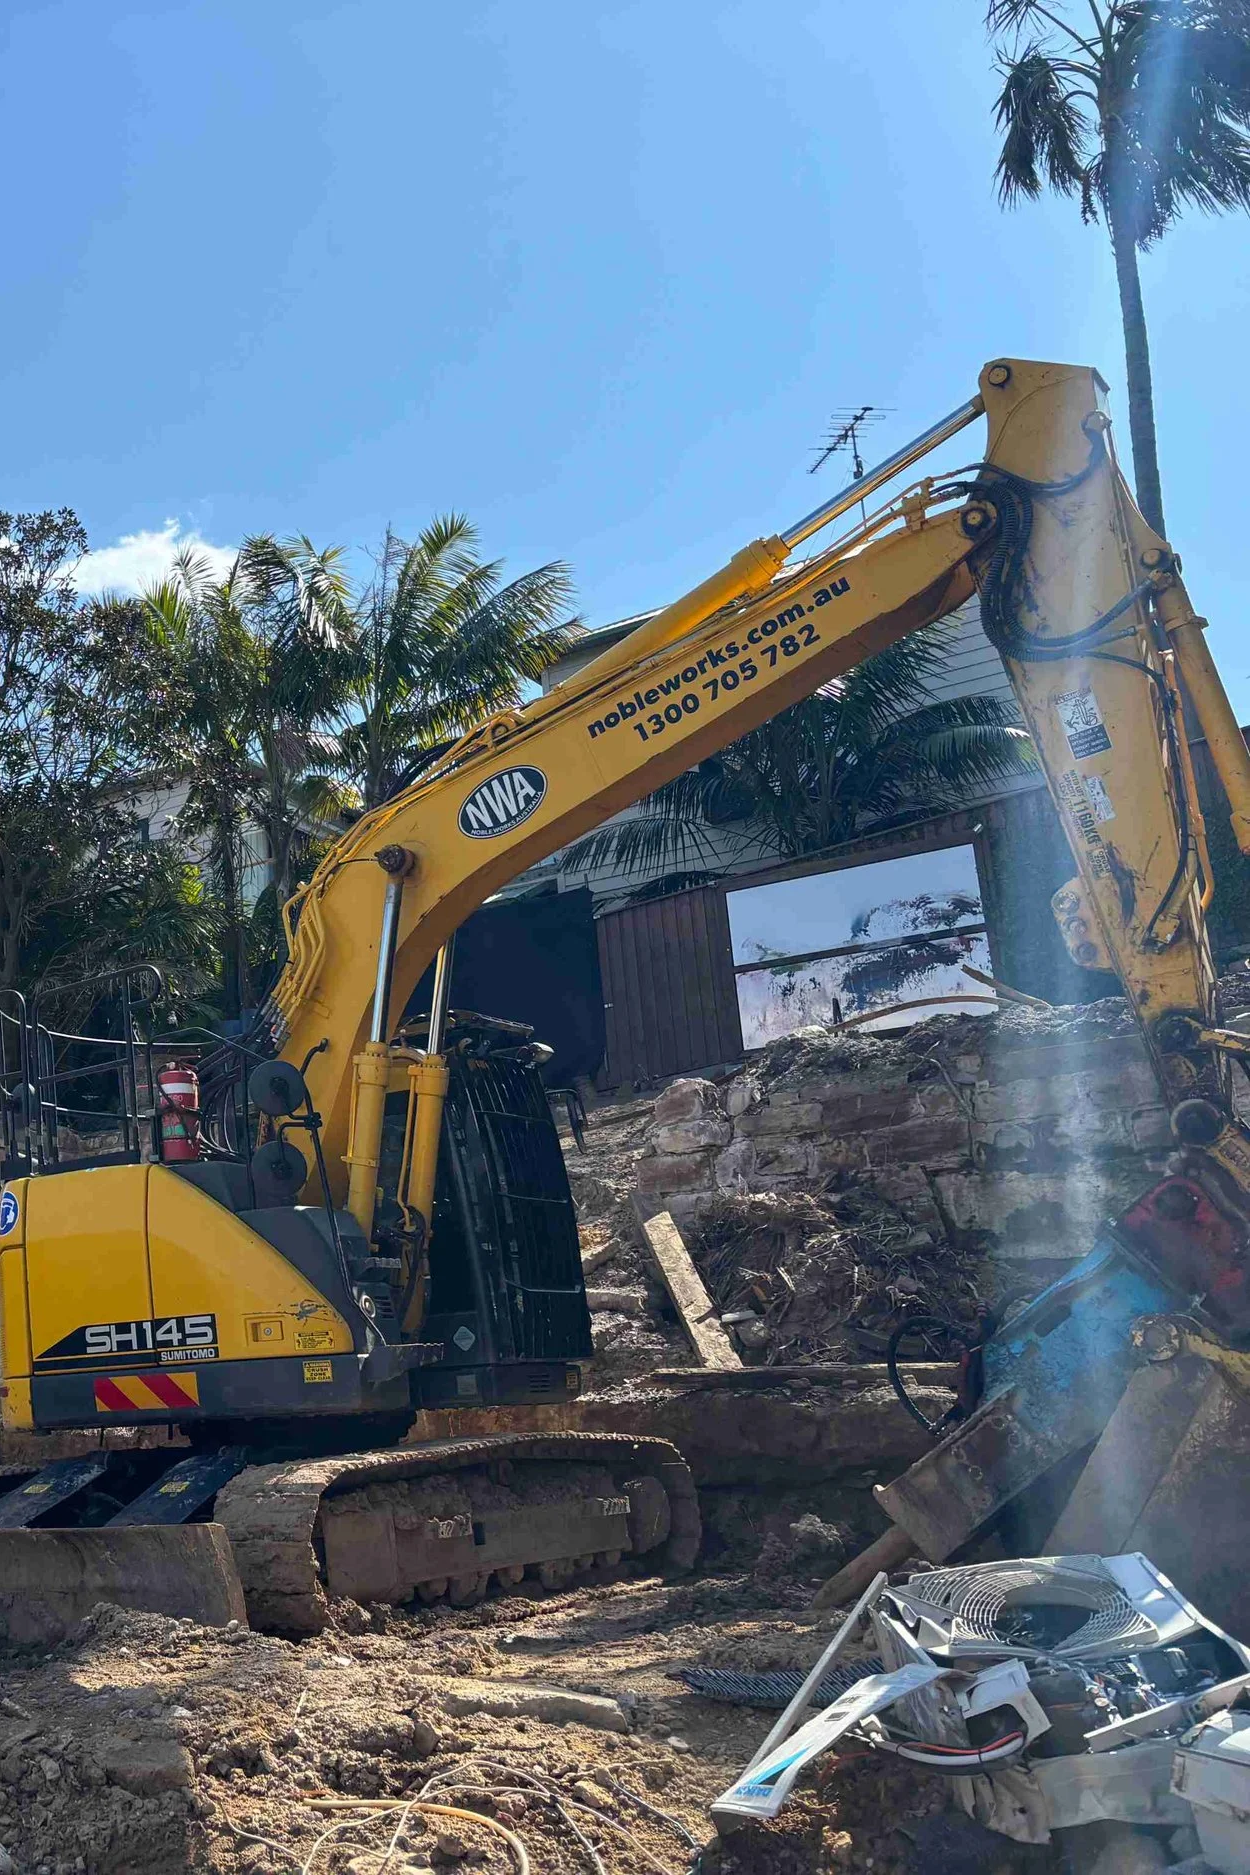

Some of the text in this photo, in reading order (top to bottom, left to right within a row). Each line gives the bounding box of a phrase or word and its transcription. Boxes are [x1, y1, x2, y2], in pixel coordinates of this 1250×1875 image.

[587, 576, 851, 739] nobleworks.com.au
[633, 623, 821, 741] 1300 705 782
[465, 771, 537, 829] NWA
[493, 820, 517, 833] WORKS
[516, 791, 543, 823] AUSTRALIA
[85, 1315, 214, 1354] SH145
[161, 1348, 215, 1361] SUMITOMO
